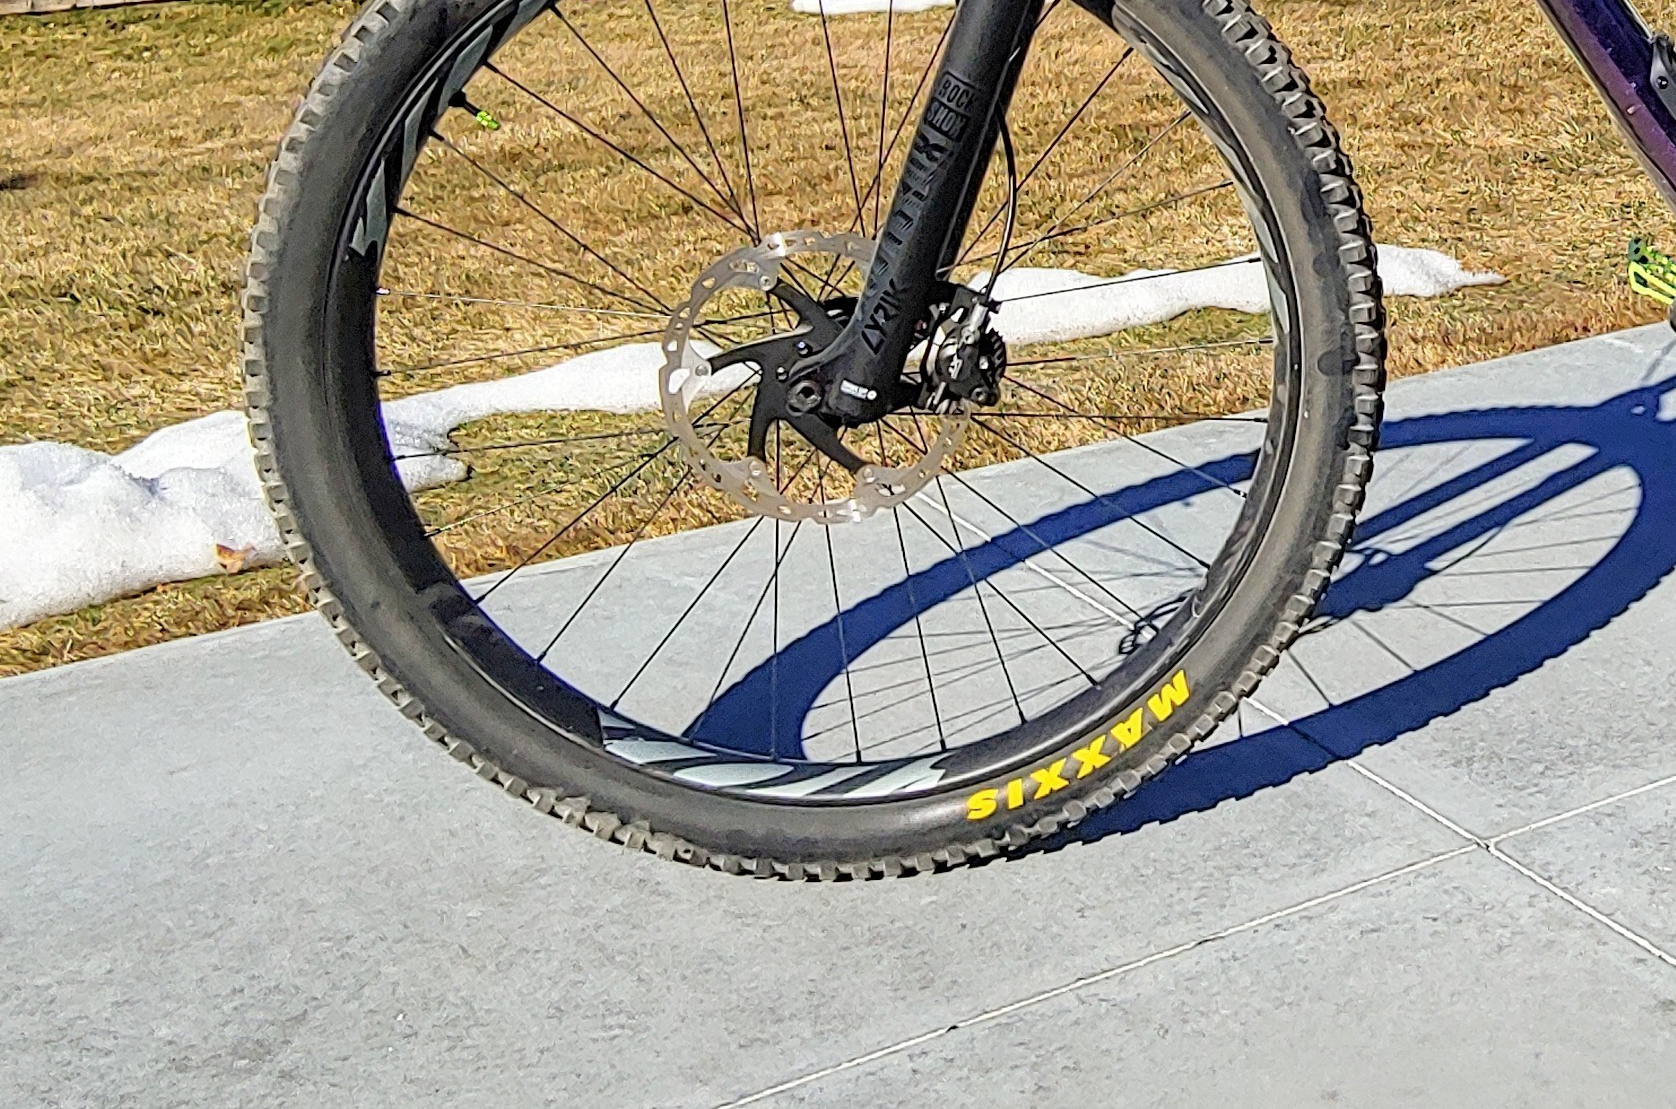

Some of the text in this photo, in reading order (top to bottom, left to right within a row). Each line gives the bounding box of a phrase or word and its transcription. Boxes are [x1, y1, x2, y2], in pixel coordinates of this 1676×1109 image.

[938, 78, 977, 112] ROCK
[861, 277, 906, 355] LYRIK
[966, 669, 1190, 821] MAXXIS
